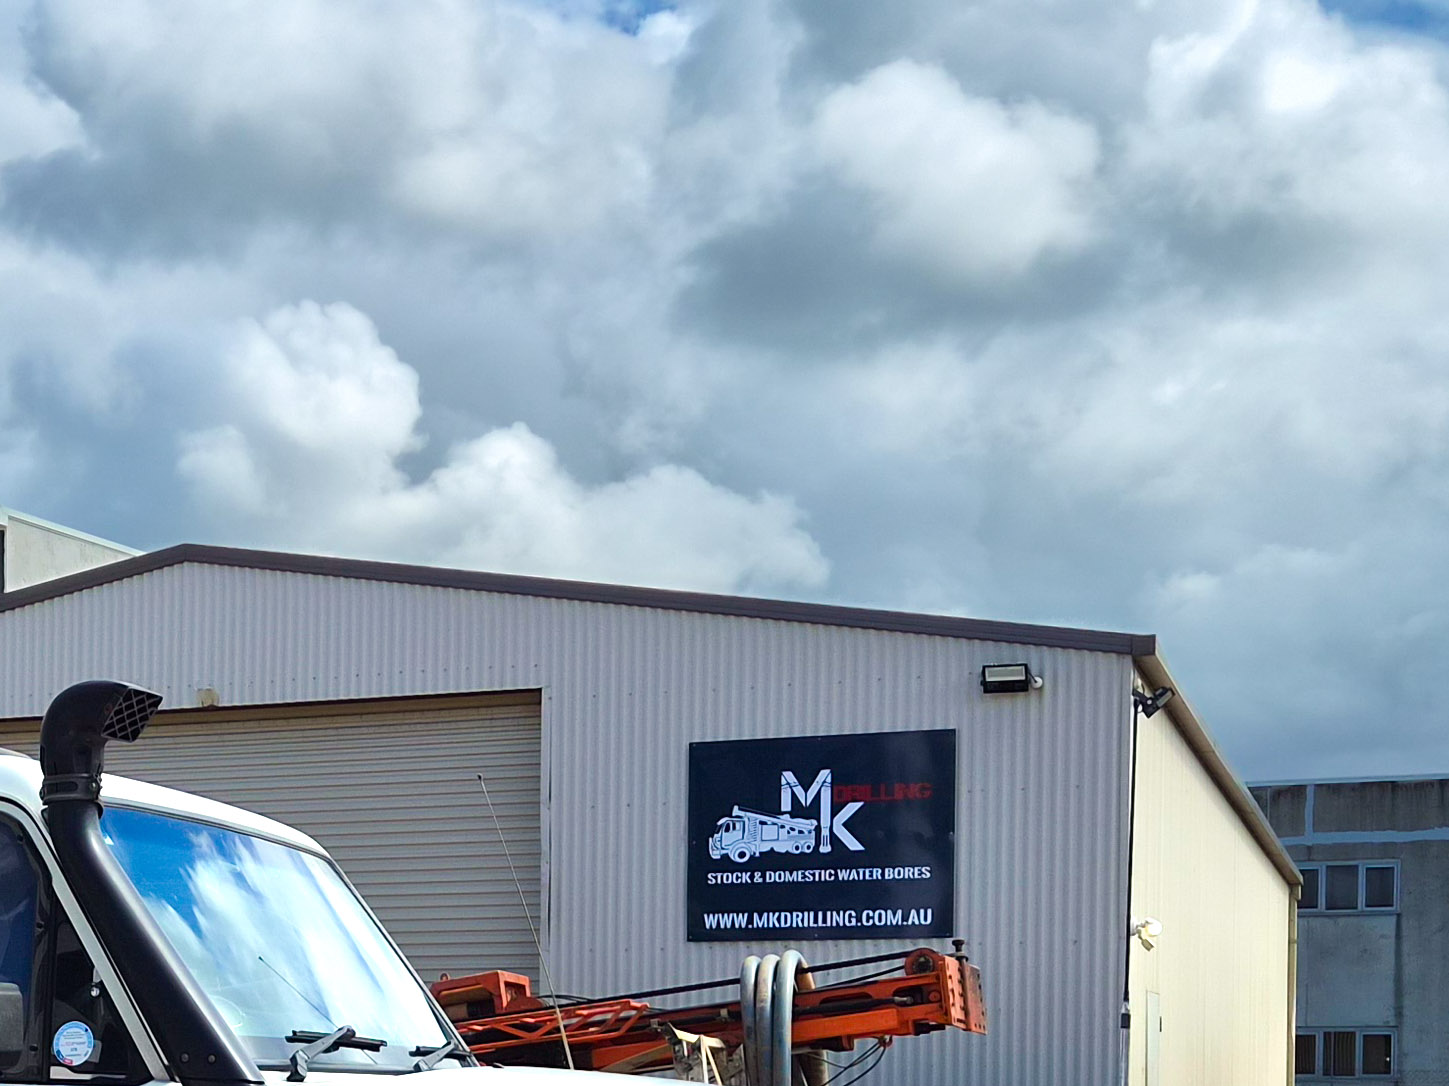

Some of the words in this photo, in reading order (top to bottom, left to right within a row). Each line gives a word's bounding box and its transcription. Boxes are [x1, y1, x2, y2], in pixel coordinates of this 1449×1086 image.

[781, 769, 865, 853] MK
[833, 782, 934, 804] DRILLING
[707, 871, 752, 885] STOCK
[753, 870, 763, 884] &
[765, 868, 835, 883] DOMESTIC
[837, 867, 882, 882] WATER
[884, 866, 932, 880] BORES
[703, 908, 933, 930] WWW.MKDRILLING.COM.AU
